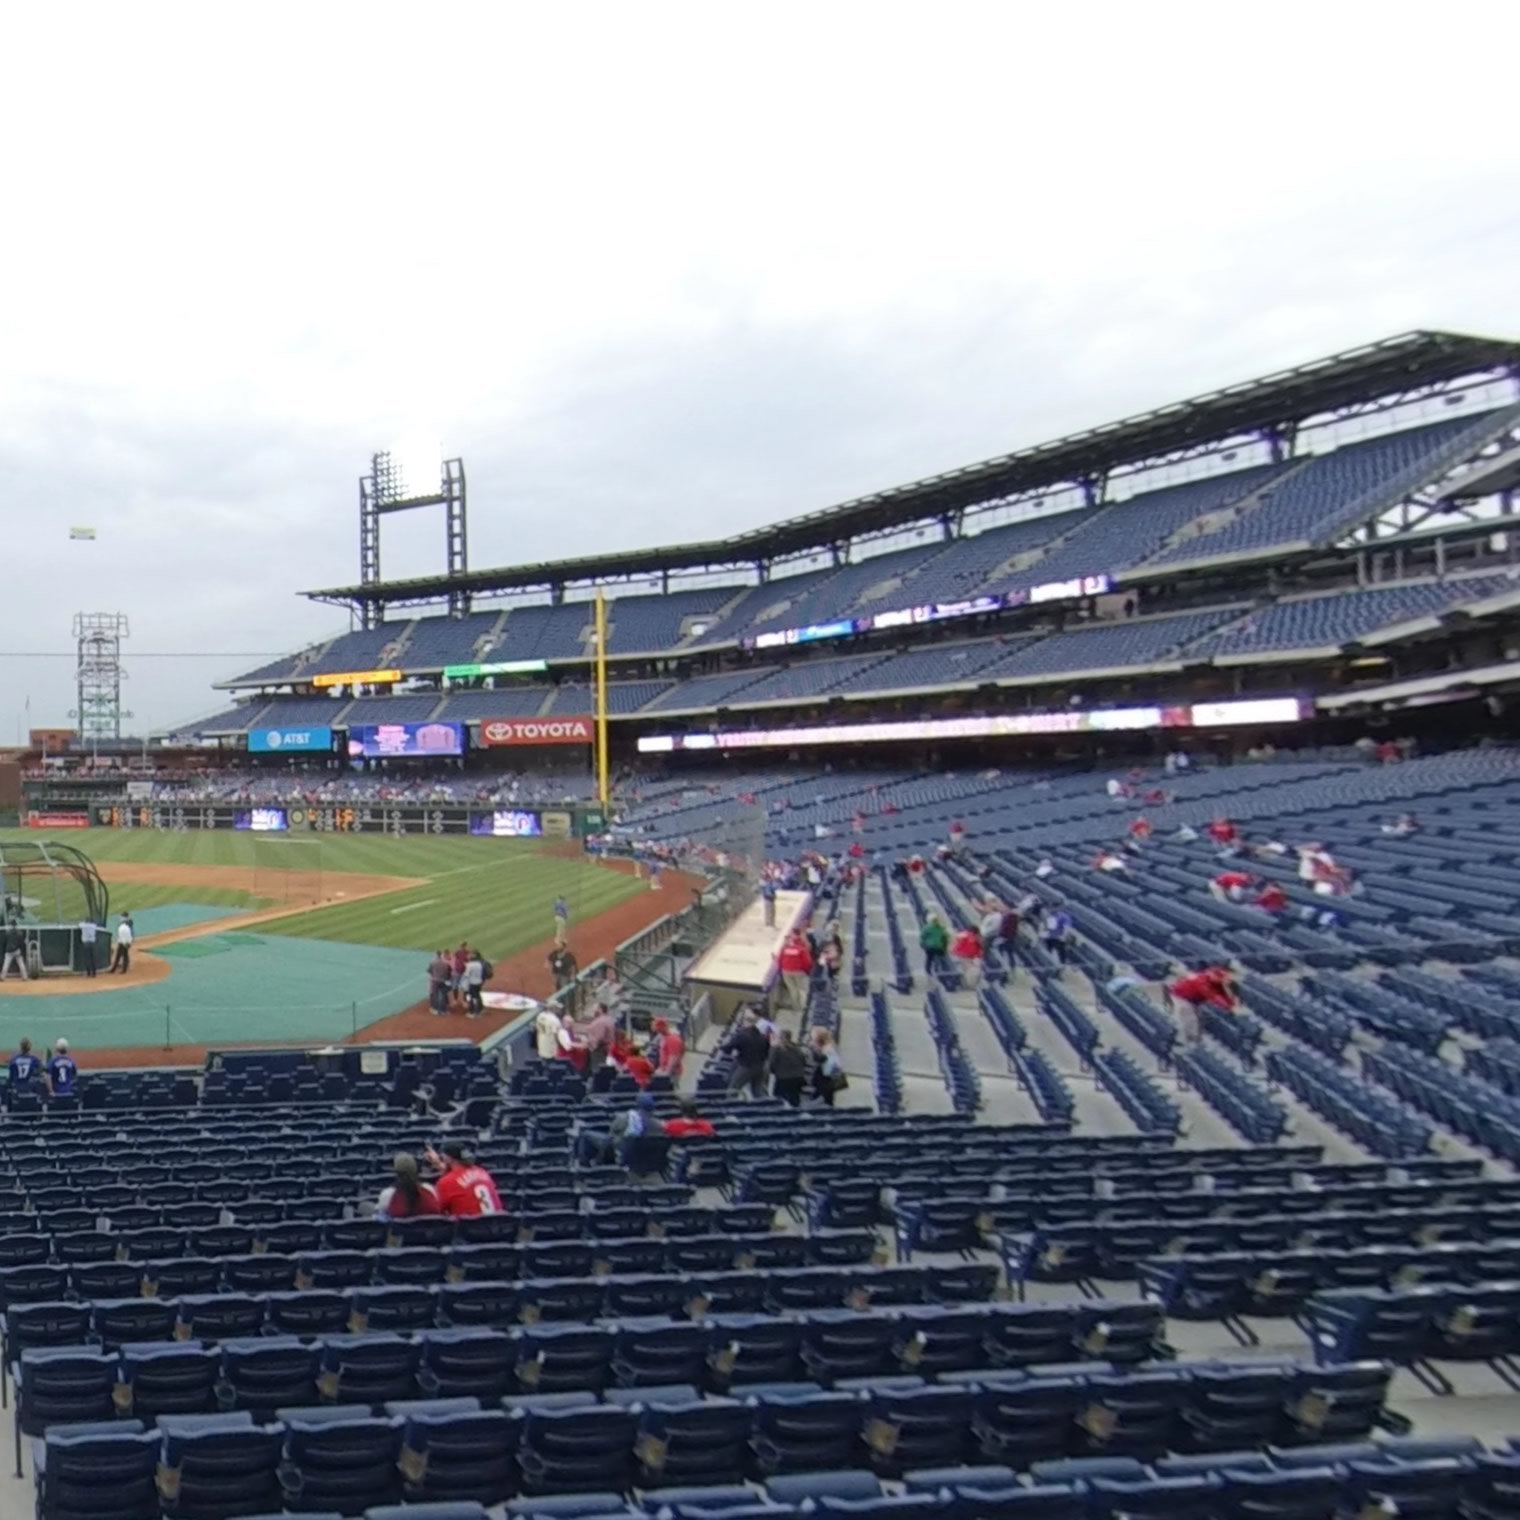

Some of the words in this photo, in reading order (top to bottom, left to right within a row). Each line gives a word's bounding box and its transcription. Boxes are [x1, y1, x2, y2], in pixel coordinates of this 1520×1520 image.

[283, 731, 311, 744] AT&T
[513, 722, 587, 738] TOYOTA
[18, 1065, 29, 1079] 17
[474, 1184, 493, 1214] 3
